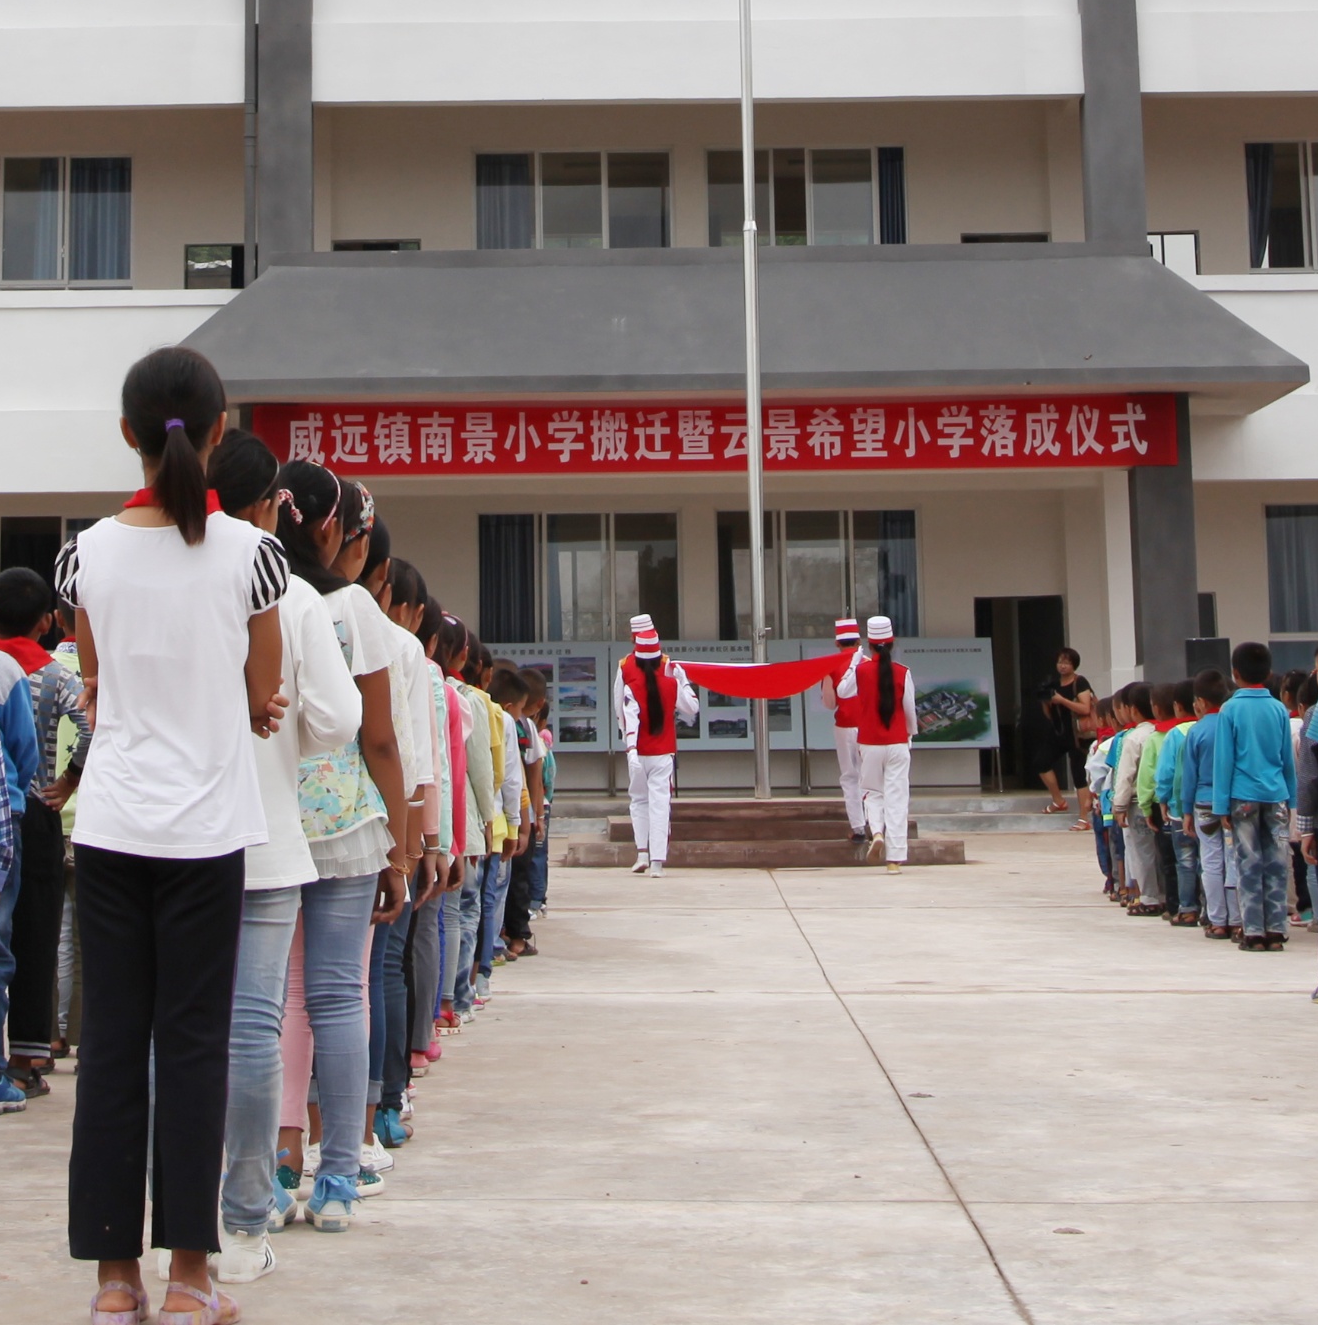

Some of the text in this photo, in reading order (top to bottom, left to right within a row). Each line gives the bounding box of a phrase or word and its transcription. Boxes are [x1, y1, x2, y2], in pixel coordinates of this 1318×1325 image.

[286, 401, 1149, 465] 威远镇南景小学搬迁暨云景希望小学落成仪式
